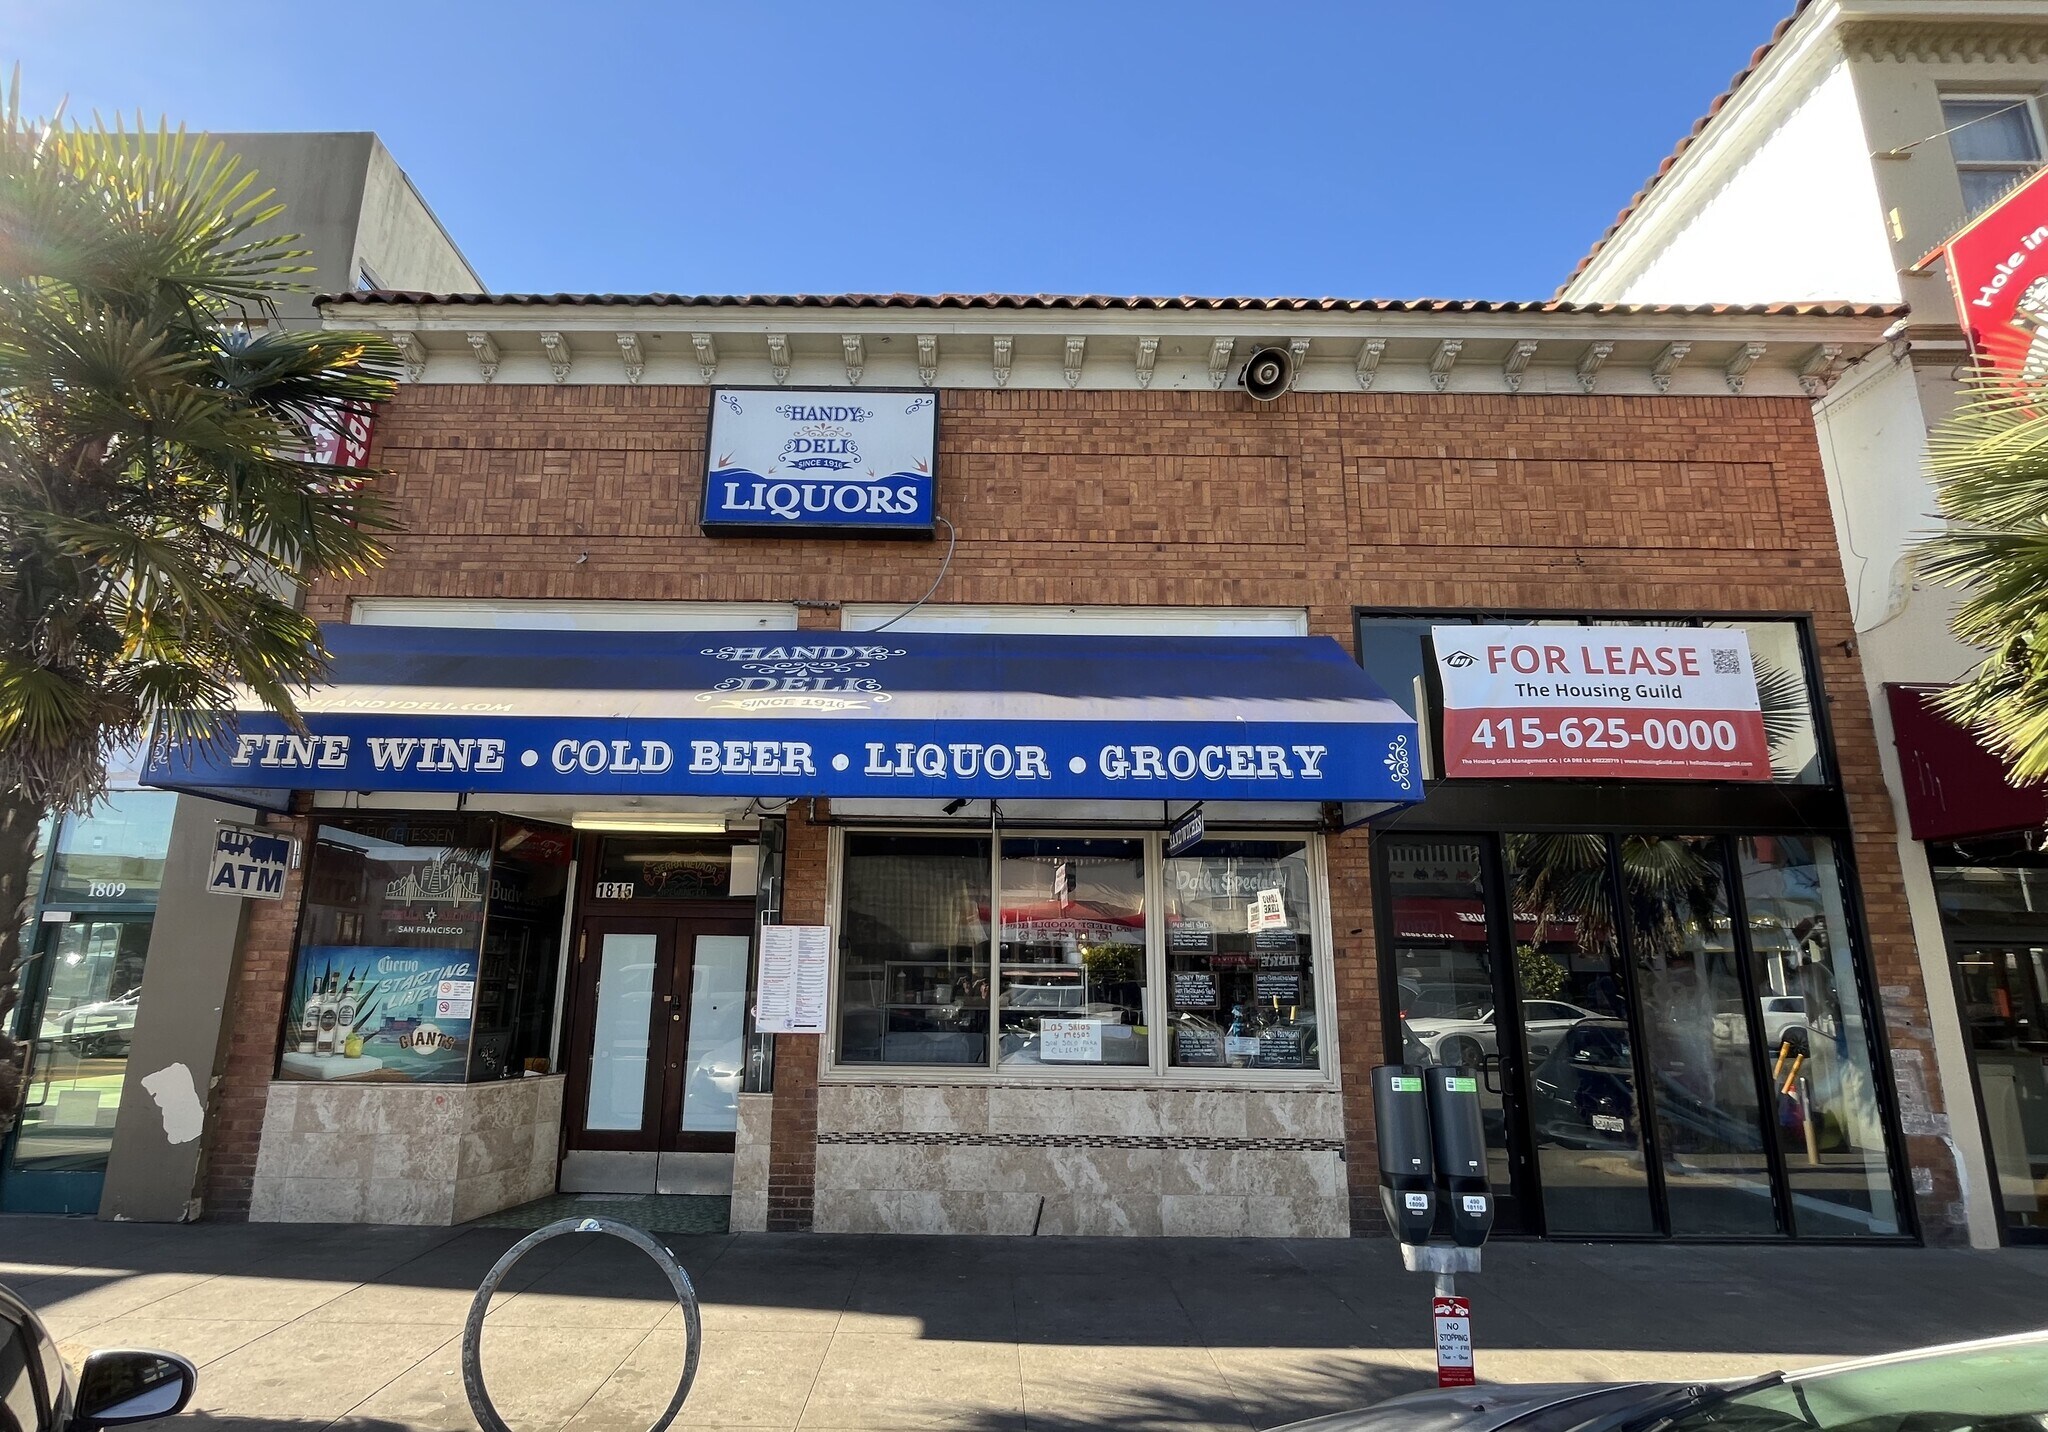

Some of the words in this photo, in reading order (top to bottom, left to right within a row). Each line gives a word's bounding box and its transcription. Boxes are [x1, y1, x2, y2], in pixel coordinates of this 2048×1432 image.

[1972, 251, 2026, 308] Hole
[790, 406, 860, 422] HANDY
[793, 438, 850, 454] DELI
[798, 459, 822, 469] SINCE
[823, 460, 844, 470] 1916
[721, 482, 919, 520] LIQUORS
[727, 646, 874, 661] HANDY
[1487, 645, 1571, 675] FOR
[1581, 645, 1701, 676] LEASE
[737, 677, 857, 692] DELI
[1514, 683, 1550, 698] The
[1555, 683, 1631, 702] Housing
[1635, 684, 1683, 699] Guild
[739, 698, 796, 709] SINCE
[798, 699, 847, 709] 1916
[1472, 718, 1737, 751] 415-625-0000
[231, 734, 350, 771] FINE
[367, 737, 505, 774] WINE
[550, 740, 674, 776] COLD
[689, 740, 816, 778] BEER
[863, 742, 1052, 780] LIQUOR
[1098, 744, 1328, 781] GROCERY
[213, 862, 283, 893] ATM
[1176, 870, 1220, 893] Daily
[87, 882, 126, 898] 1809
[598, 883, 634, 898] 1815
[398, 925, 415, 934] SAN
[416, 925, 464, 935] FRANCISCO
[377, 955, 419, 974] Cuervo
[380, 963, 470, 994] STARTING
[1042, 1020, 1063, 1031] Las
[399, 1031, 455, 1051] GIANTS
[1051, 1046, 1095, 1055] CLIENTES
[1446, 1322, 1459, 1331] NO
[1439, 1333, 1469, 1342] STOPPING
